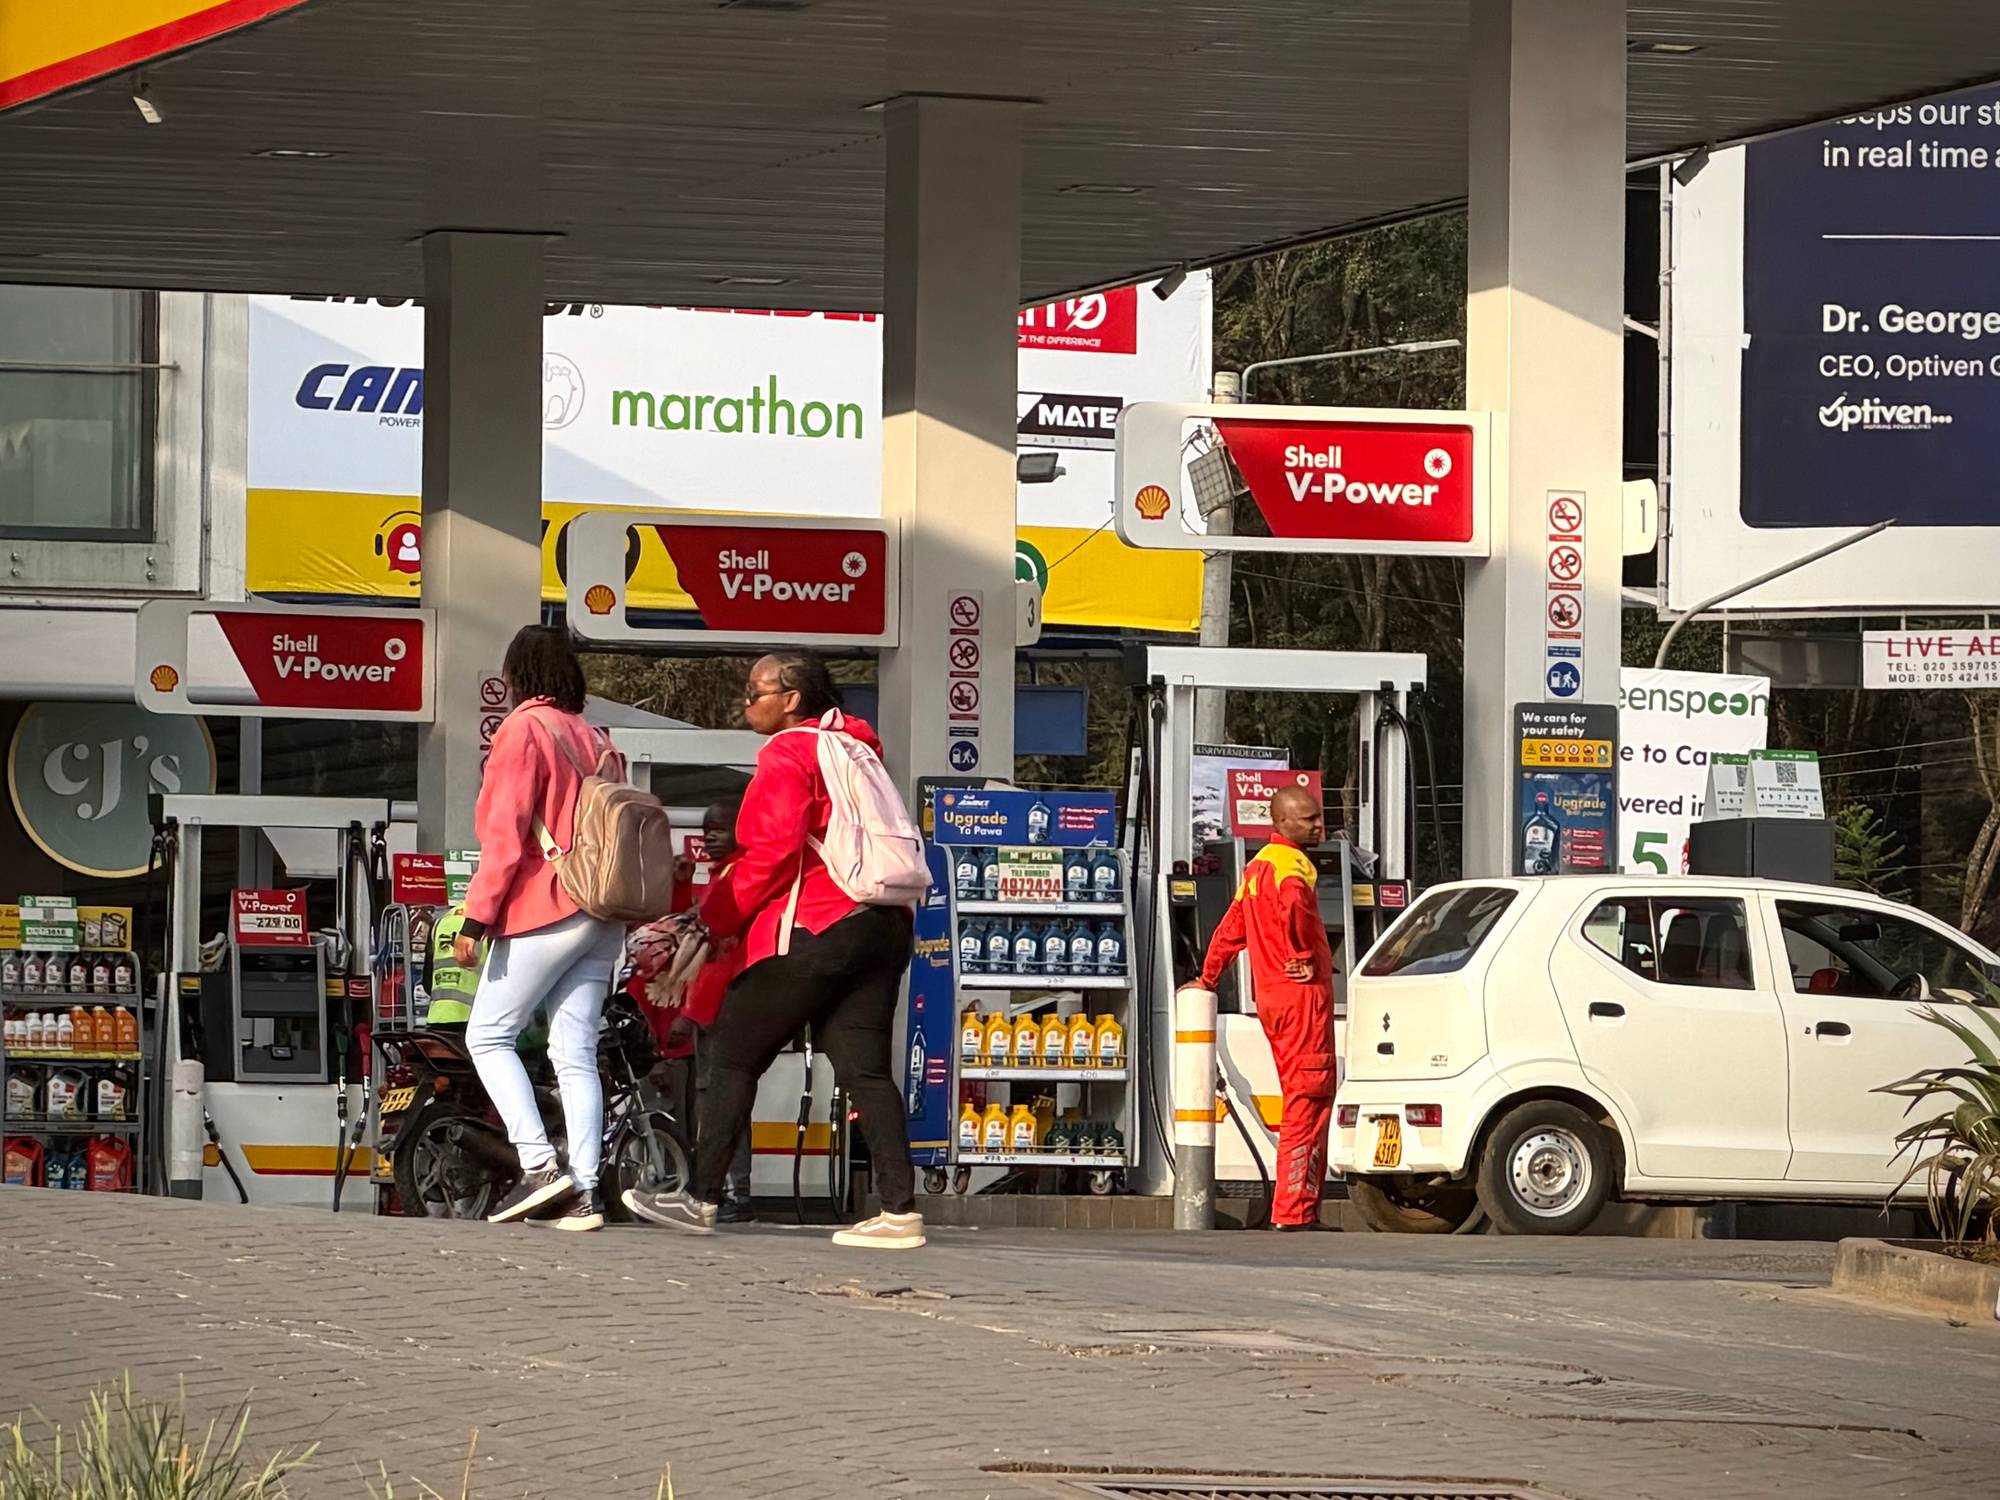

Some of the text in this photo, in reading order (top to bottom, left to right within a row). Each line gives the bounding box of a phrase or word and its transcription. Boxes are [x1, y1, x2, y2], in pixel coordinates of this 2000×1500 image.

[1919, 104, 1972, 126] our
[1823, 139, 1850, 167] in
[1858, 139, 1912, 168] real
[1919, 140, 1989, 168] time
[1822, 304, 2000, 340] Dr. George
[1819, 354, 1880, 379] CEO,
[1886, 354, 1984, 381] Optiven
[612, 374, 863, 439] marathon
[379, 416, 421, 428] POWER
[1284, 445, 1342, 469] Shell
[1286, 472, 1440, 506] V-Power
[718, 549, 769, 571] Shell
[719, 573, 855, 602] V-Power
[1027, 597, 1036, 628] 3
[272, 634, 318, 653] Shell
[1887, 636, 1954, 658] LIVE
[272, 655, 396, 682] V-Power
[1887, 661, 2000, 672] TEL: 020 359705
[1888, 673, 1921, 683] MOB:
[1926, 673, 1954, 682] 0705
[1522, 712, 1587, 724] We care for
[1522, 725, 1585, 738] your safety
[1643, 744, 1667, 763] to
[1235, 772, 1262, 783] Shell
[1236, 783, 1278, 798] V-Po
[1553, 795, 1607, 811] Upgrade
[944, 810, 1008, 828] Upgrade
[974, 825, 1003, 836] Pawa
